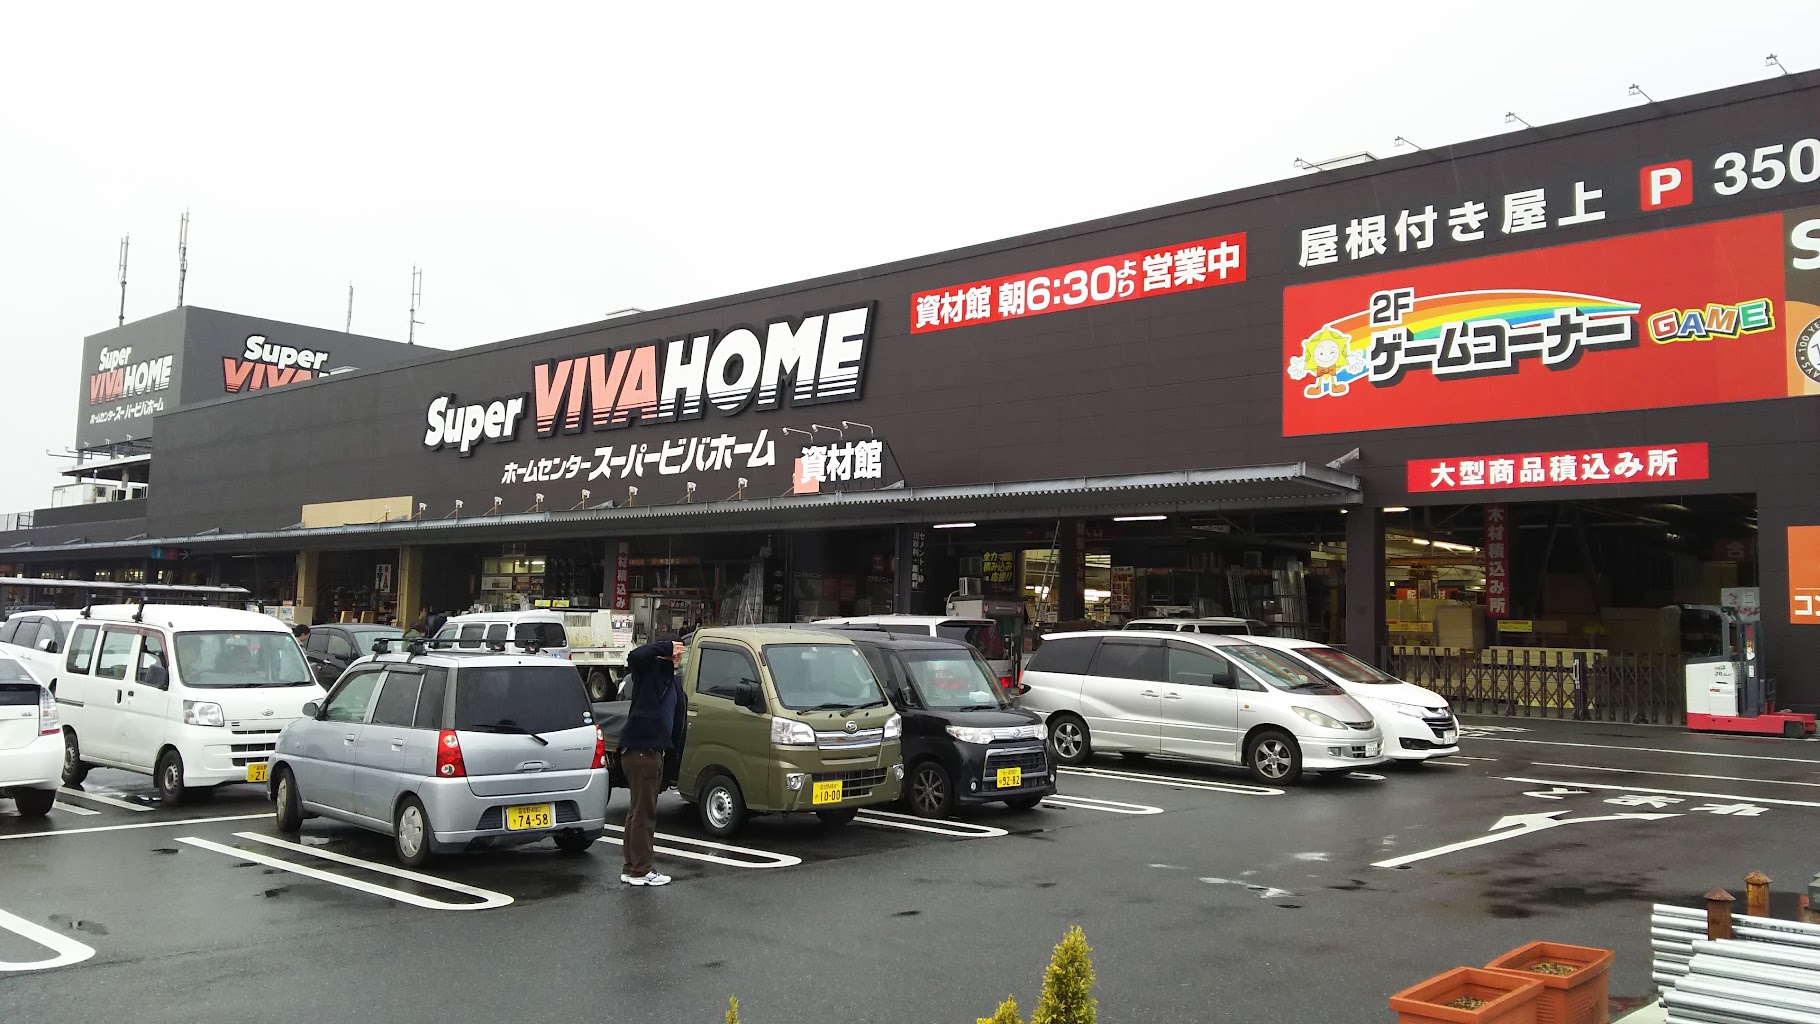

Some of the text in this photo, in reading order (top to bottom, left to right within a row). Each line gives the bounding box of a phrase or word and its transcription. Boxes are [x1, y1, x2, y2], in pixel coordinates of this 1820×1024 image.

[1299, 182, 1606, 269] 屋根付き屋上
[1713, 138, 1820, 195] 350
[916, 285, 992, 329] 資材館
[1371, 288, 1414, 325] 2F
[1651, 300, 1774, 342] GAME
[98, 346, 132, 373] Super
[244, 334, 329, 370] Super
[1369, 307, 1635, 382] ゲームコーナー
[90, 354, 174, 405] VIVAHOME
[223, 357, 330, 394] VIVA
[424, 307, 869, 453] Super VIVAHOME
[801, 439, 883, 483] 資材館
[1430, 448, 1678, 488] 大型商品積込み所
[1487, 506, 1506, 614] 木材積込み所
[518, 813, 549, 827] 74-58
